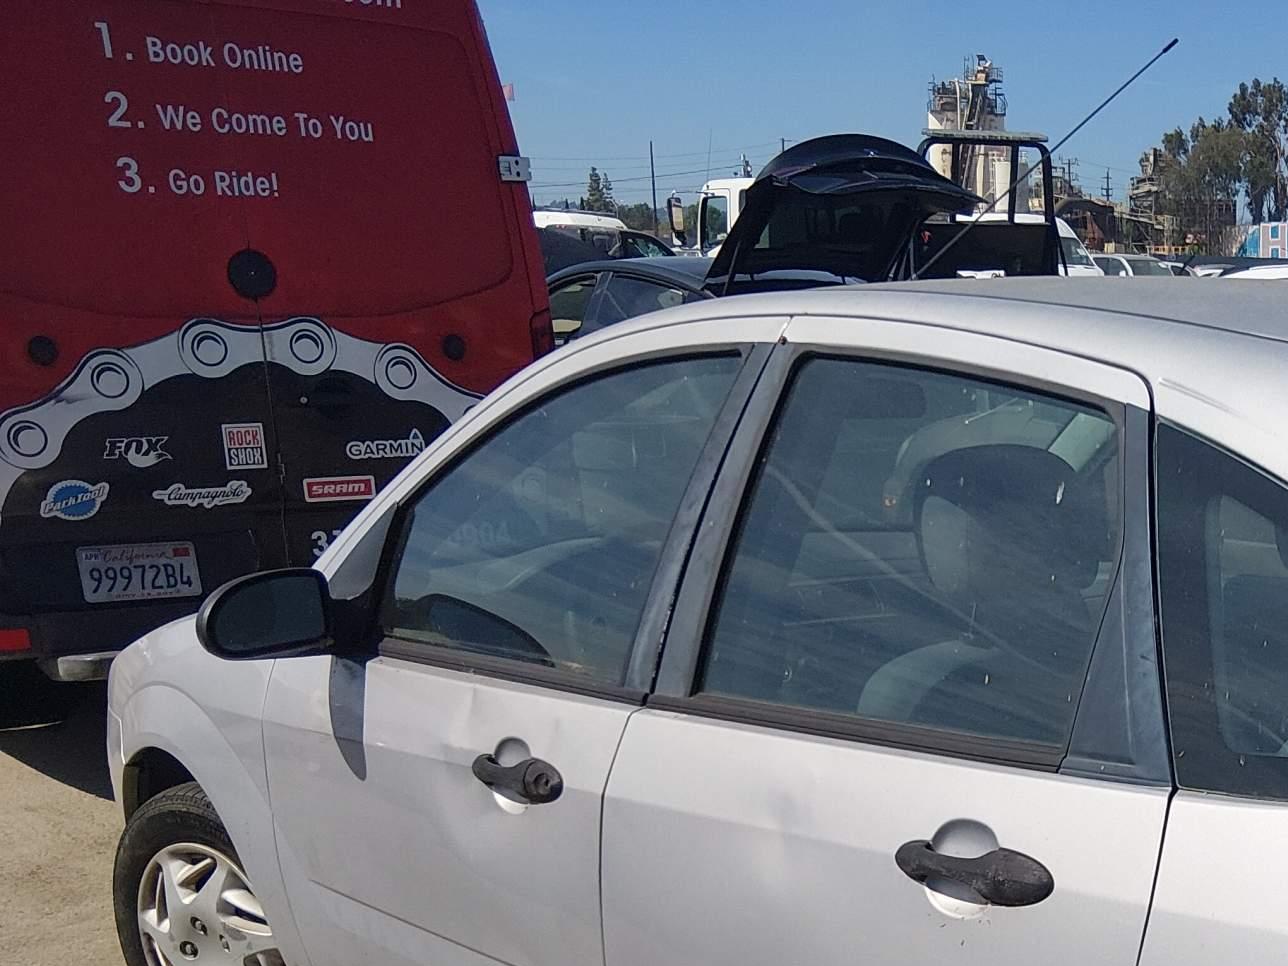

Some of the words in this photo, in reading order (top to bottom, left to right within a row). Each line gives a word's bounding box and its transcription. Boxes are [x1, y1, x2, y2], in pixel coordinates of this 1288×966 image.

[94, 21, 133, 60] 1.
[146, 36, 216, 67] Book
[223, 42, 304, 73] Online
[104, 91, 145, 128] 2.
[155, 104, 201, 131] We
[211, 107, 287, 136] Come
[294, 112, 323, 138] To
[329, 115, 374, 142] You
[116, 157, 155, 193] 3.
[168, 169, 205, 195] Go
[214, 171, 279, 197] Ride!
[105, 437, 168, 460] FOX
[228, 430, 260, 446] ROCK
[348, 441, 424, 457] GARMIN
[230, 448, 262, 465] SHOX
[165, 483, 248, 505] Campagnolo
[311, 483, 368, 495] SRAM
[88, 562, 194, 594] 99972B4
